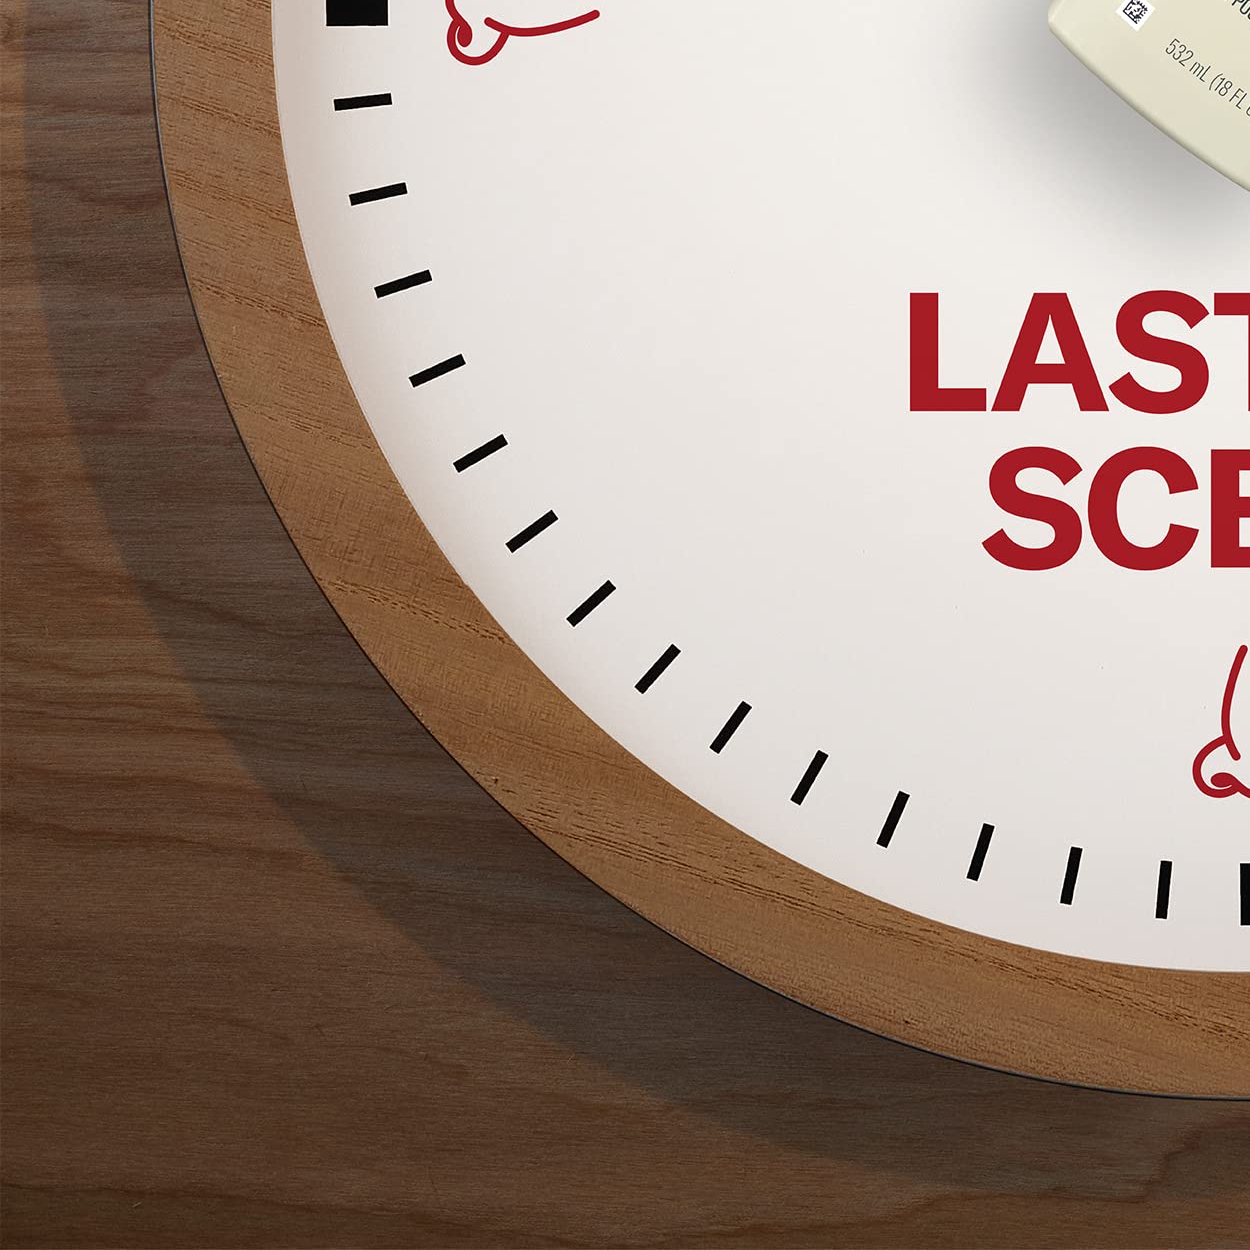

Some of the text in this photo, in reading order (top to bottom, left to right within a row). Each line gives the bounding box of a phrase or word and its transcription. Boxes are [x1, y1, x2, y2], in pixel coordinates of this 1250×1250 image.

[1165, 38, 1194, 67] 532
[1190, 60, 1210, 83] mL
[1209, 73, 1233, 97] (18
[1229, 88, 1246, 109] FL
